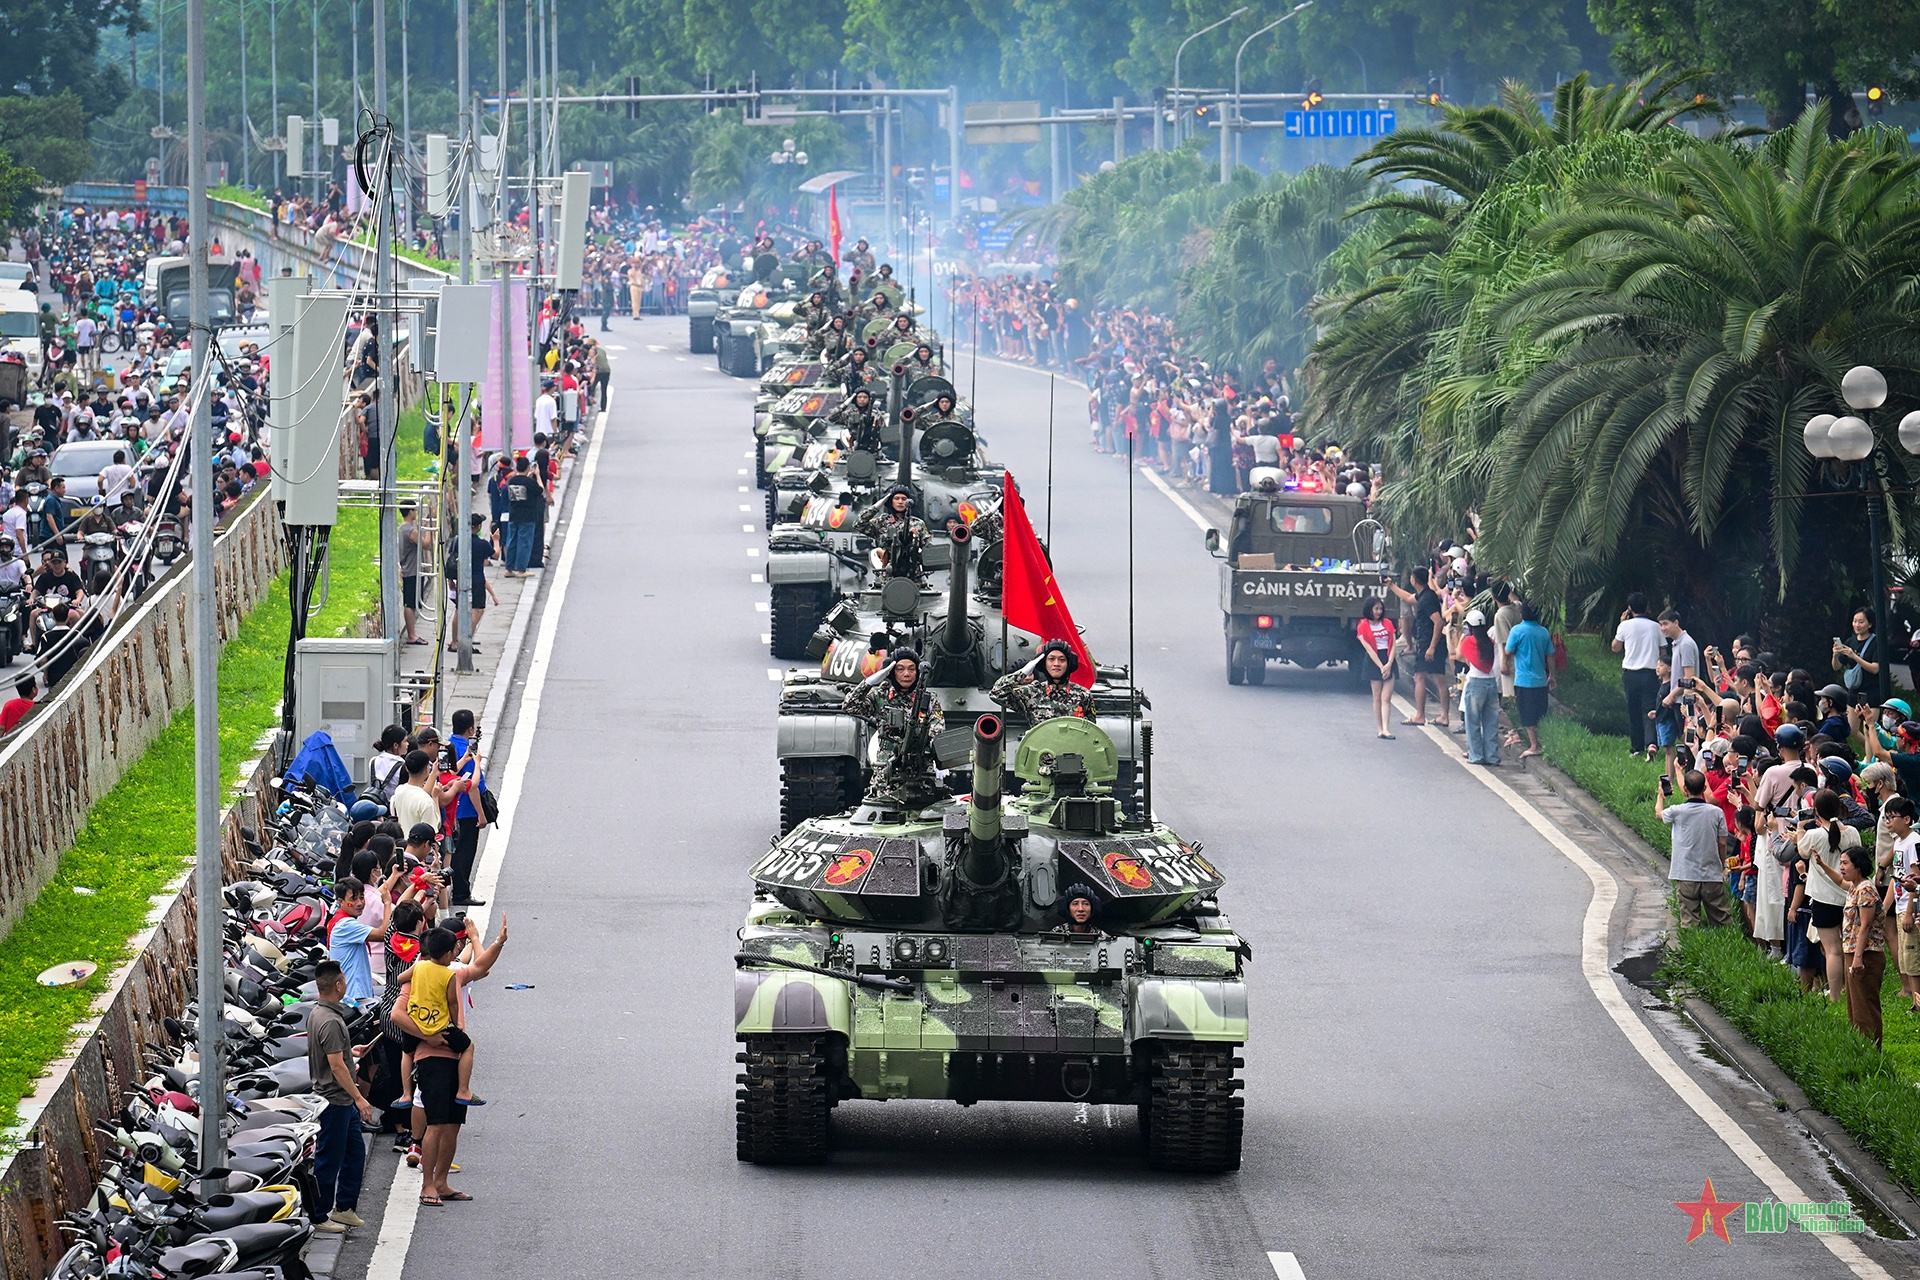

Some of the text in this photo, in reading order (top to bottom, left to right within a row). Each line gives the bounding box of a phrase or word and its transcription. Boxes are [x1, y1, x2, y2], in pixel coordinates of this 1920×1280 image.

[805, 497, 835, 526] 134
[1243, 577, 1290, 595] CẢNH
[1294, 579, 1323, 596] SÁT
[1327, 582, 1365, 601] TRẬT
[830, 639, 868, 678] 135
